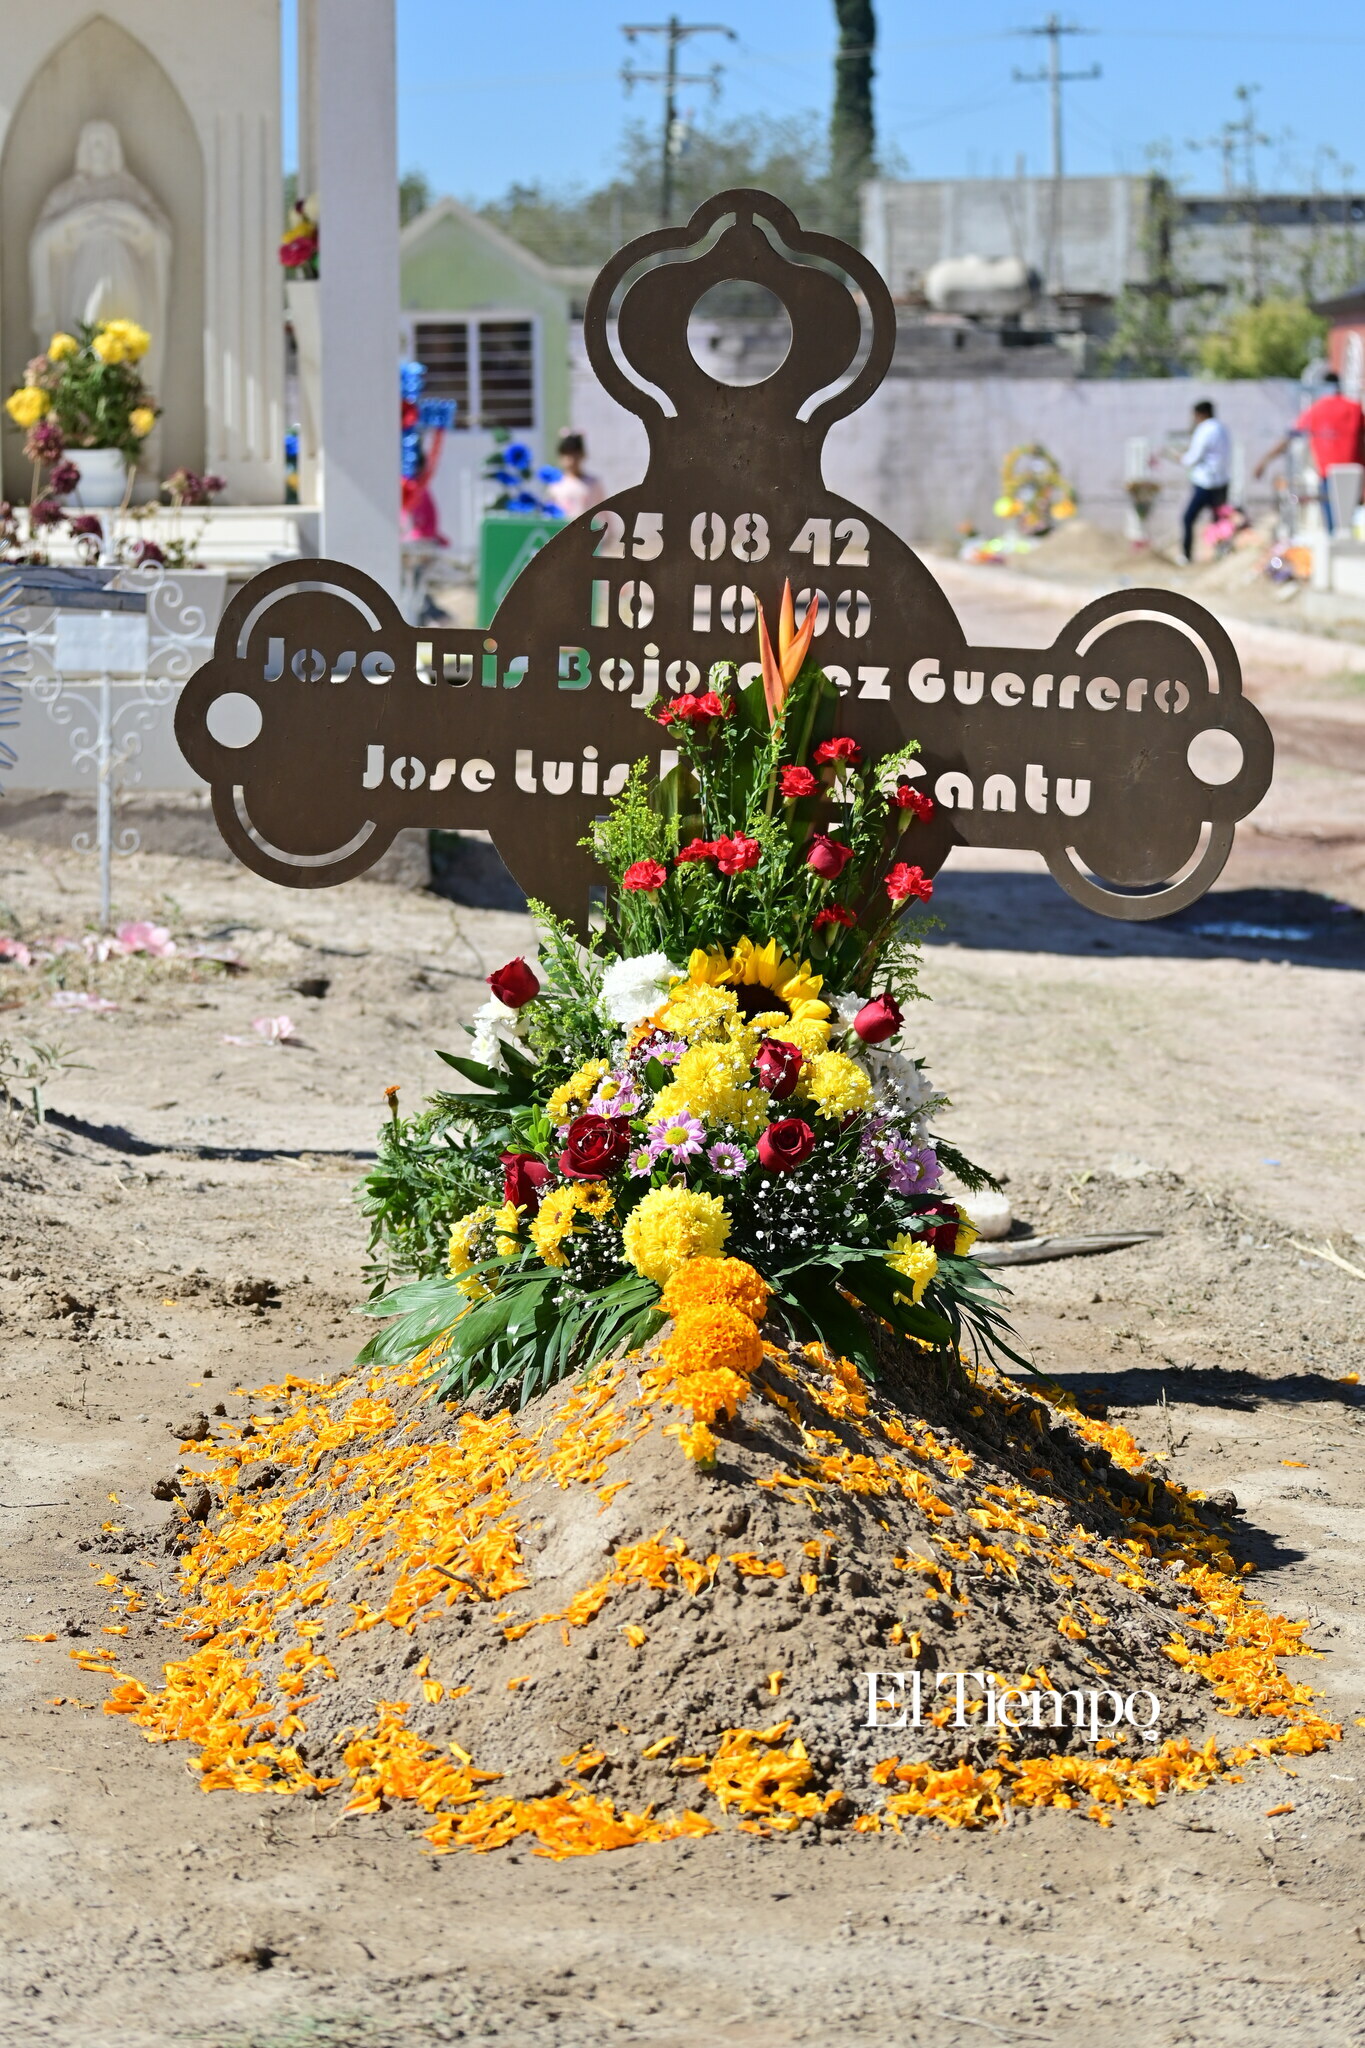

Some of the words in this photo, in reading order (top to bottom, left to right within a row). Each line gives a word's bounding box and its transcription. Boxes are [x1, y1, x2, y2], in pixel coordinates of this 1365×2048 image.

[590, 510, 664, 562] 25
[690, 511, 770, 563] 08
[789, 518, 870, 567] 42
[590, 579, 655, 630] 10
[692, 584, 757, 634] 10
[794, 587, 872, 639] 00
[263, 636, 396, 685] Jose
[415, 637, 529, 690] Luis
[907, 657, 1190, 715] Guerrero
[361, 744, 496, 792] Jose
[514, 745, 631, 797] Luis
